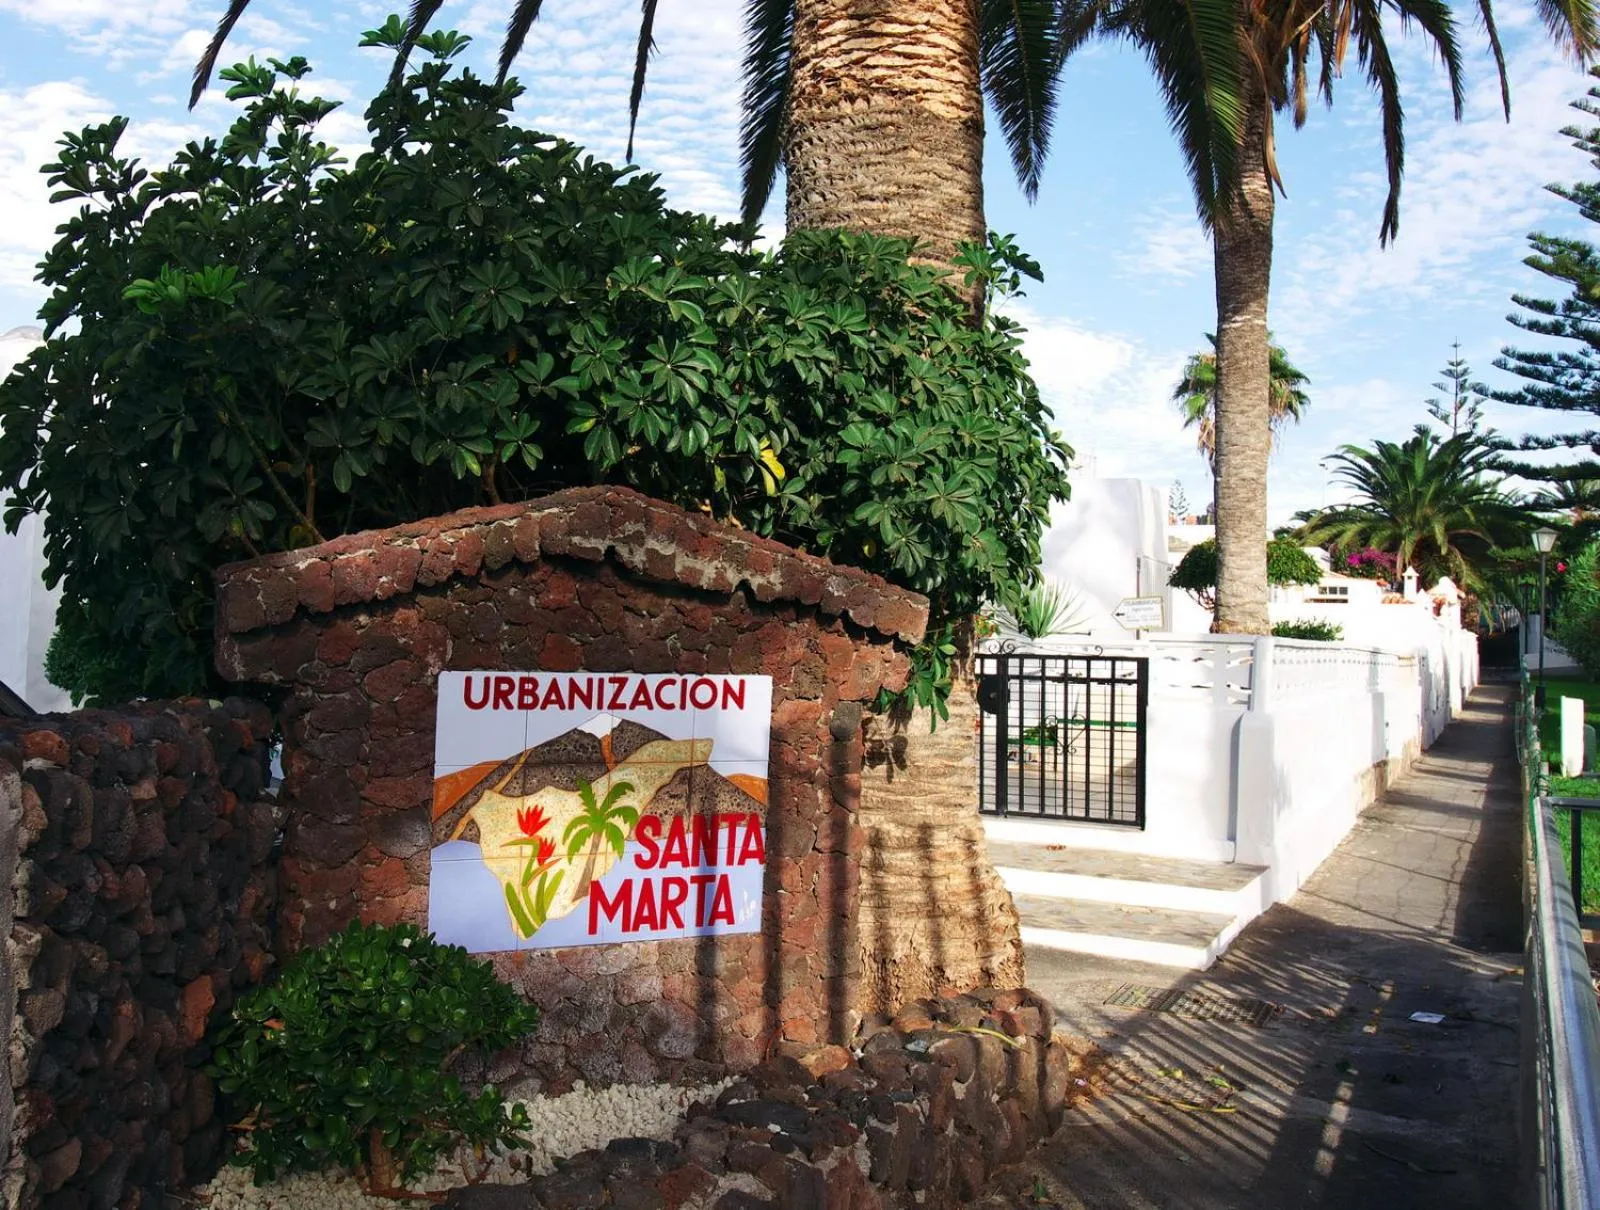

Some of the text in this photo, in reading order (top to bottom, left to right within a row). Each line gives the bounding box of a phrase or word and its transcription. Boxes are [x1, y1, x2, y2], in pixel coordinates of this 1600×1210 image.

[463, 676, 746, 711] URBANIZACION
[634, 812, 766, 870] SANTA
[588, 874, 735, 935] MARTA
